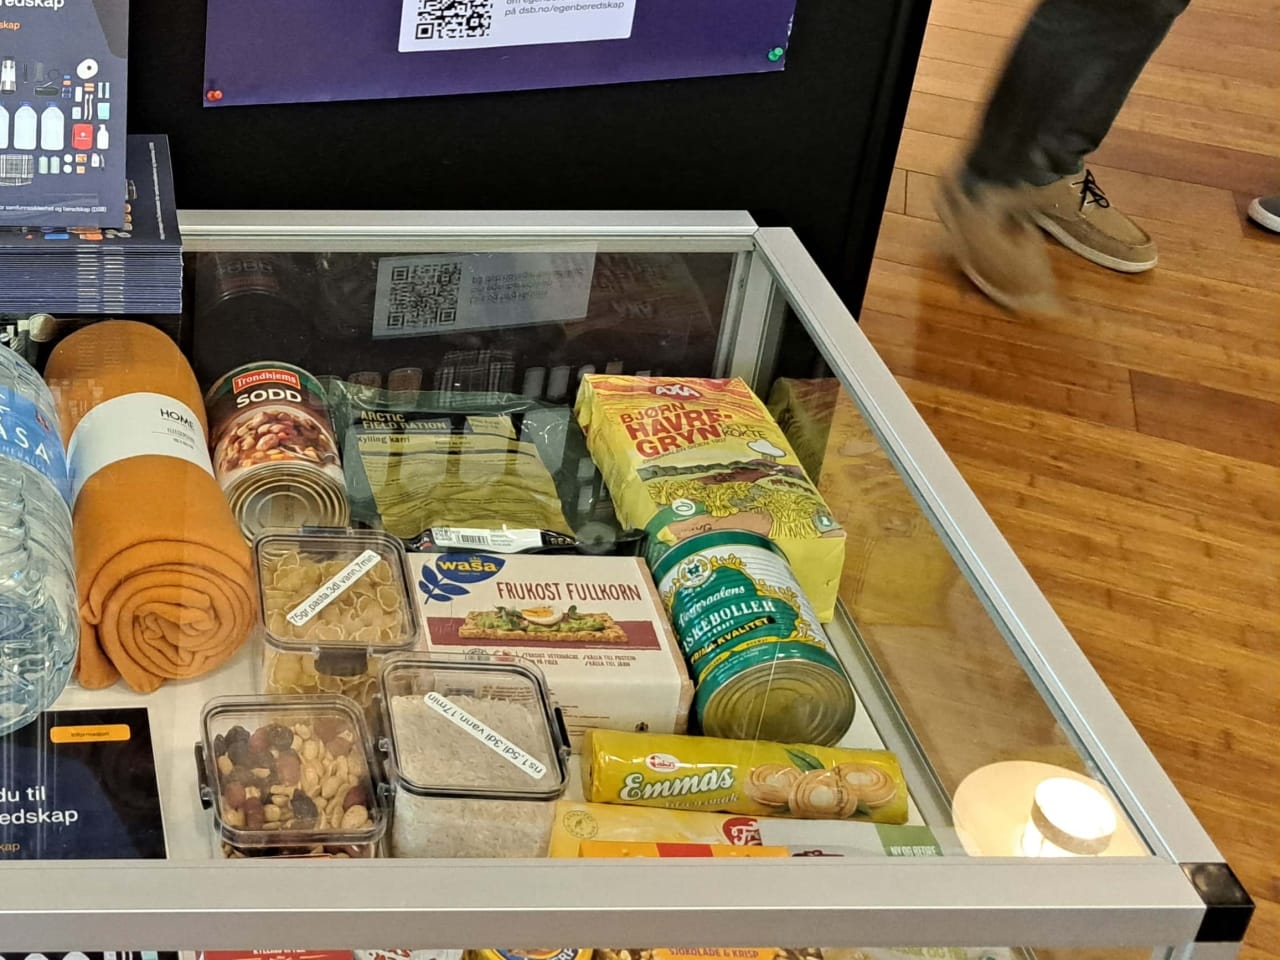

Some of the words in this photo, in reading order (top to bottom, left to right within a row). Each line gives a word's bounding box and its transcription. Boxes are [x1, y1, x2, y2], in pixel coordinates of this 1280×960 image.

[505, 6, 516, 16] på
[519, 1, 624, 15] dsb.no/egenberedskap
[236, 389, 302, 409] SODD
[655, 384, 701, 397] AXA
[360, 411, 406, 422] ARCTIC
[620, 402, 686, 424] BJØRN
[364, 421, 398, 430] FIELD
[401, 421, 447, 430] RATION
[625, 408, 733, 440] HAVRE-
[636, 424, 722, 458] GRYN
[496, 582, 562, 601] FRUKOST
[567, 583, 643, 601] FULLKORN
[682, 599, 777, 653] ISKEBOLLER
[27, 786, 46, 800] til
[620, 768, 734, 800] Emmas
